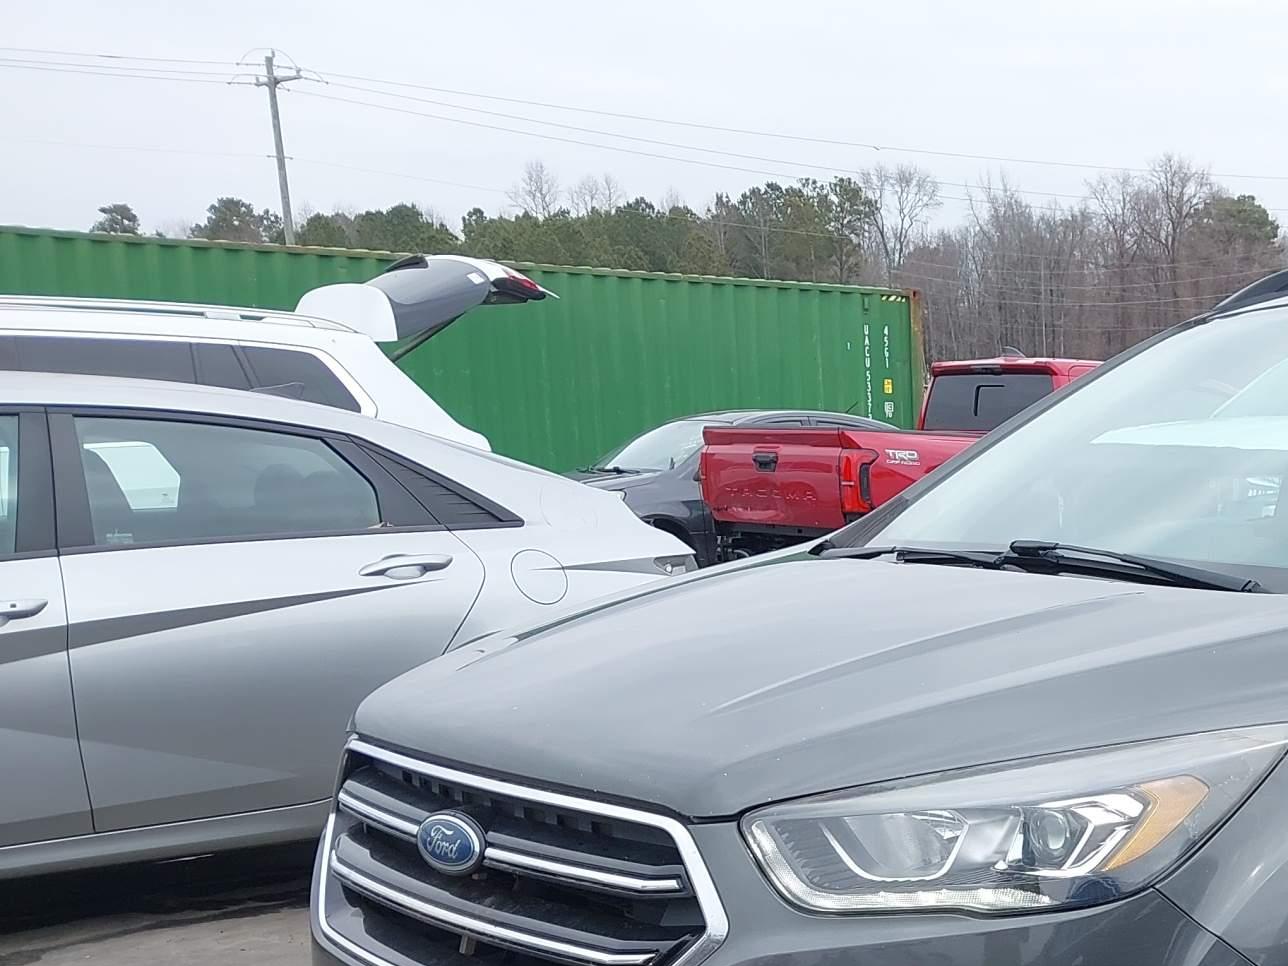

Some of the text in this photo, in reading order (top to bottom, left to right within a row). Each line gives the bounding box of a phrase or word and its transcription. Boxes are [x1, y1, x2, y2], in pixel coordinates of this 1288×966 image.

[885, 449, 918, 460] TRD
[725, 487, 816, 501] TACOMA
[426, 825, 461, 859] Ford
